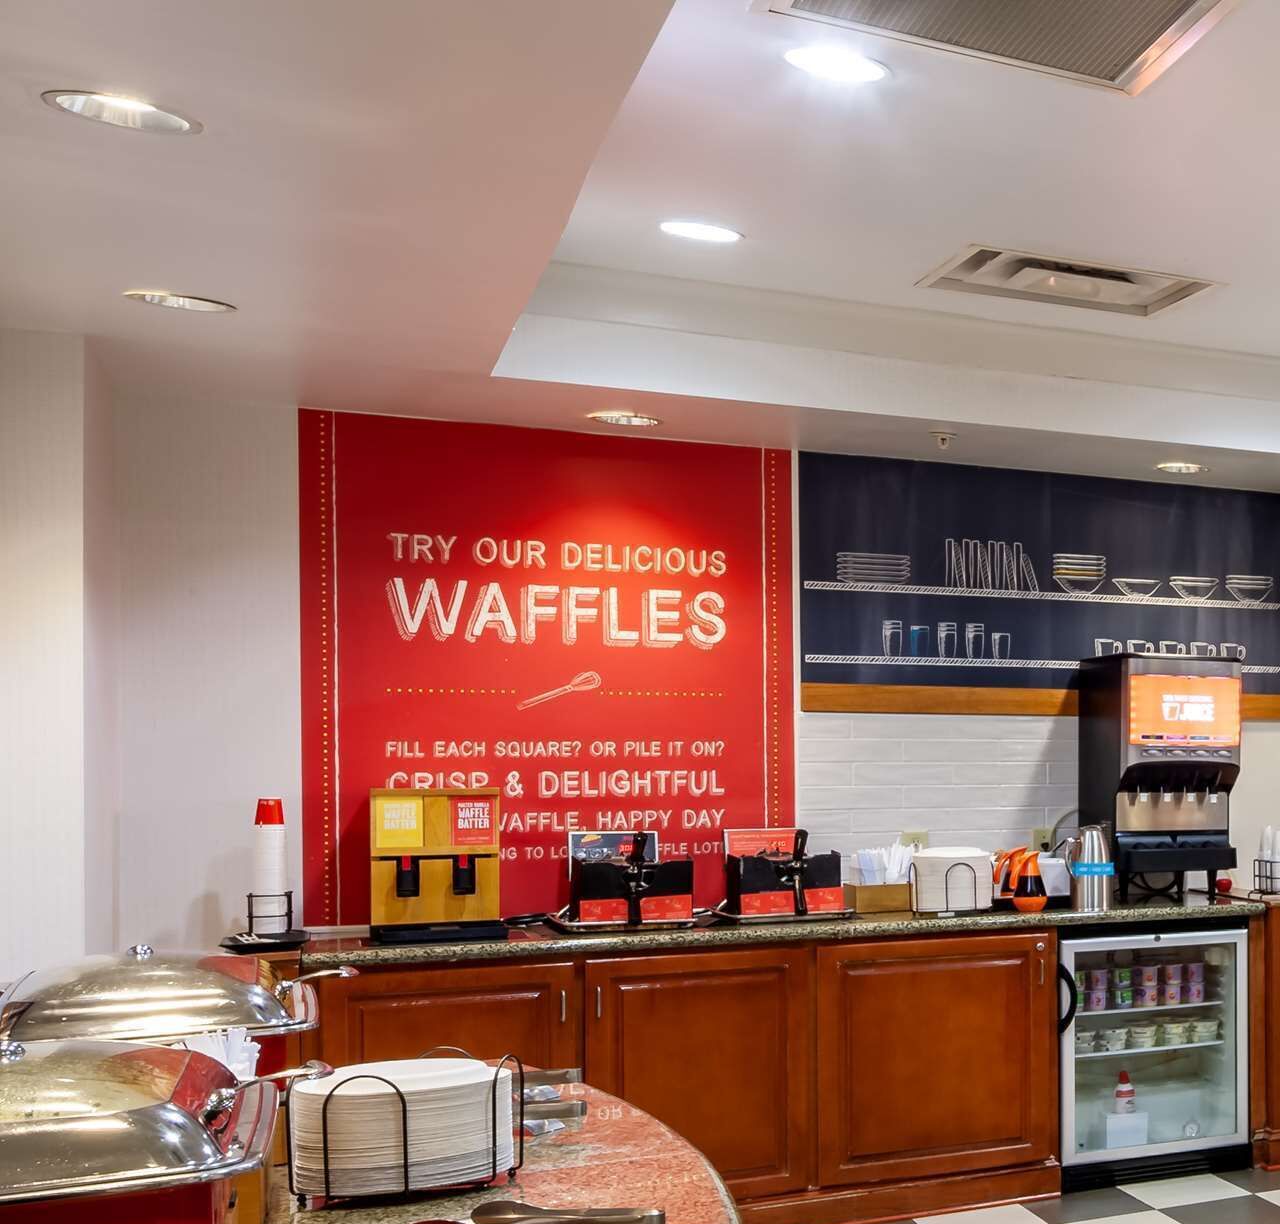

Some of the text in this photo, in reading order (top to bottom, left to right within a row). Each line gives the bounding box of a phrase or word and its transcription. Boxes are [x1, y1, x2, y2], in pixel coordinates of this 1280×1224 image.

[387, 532, 727, 577] TRY OUR DELICIOUS
[385, 577, 727, 650] WAFFLES
[385, 741, 725, 758] FILL EACH SQUARE? OR PILE IT ON?
[505, 770, 524, 797] &
[538, 770, 726, 798] DELIGHTFUL
[458, 808, 490, 818] WAFFLE
[596, 810, 673, 831] HAPPY
[682, 809, 726, 829] DAY
[458, 818, 490, 829] BATTER
[525, 846, 544, 860] TO
